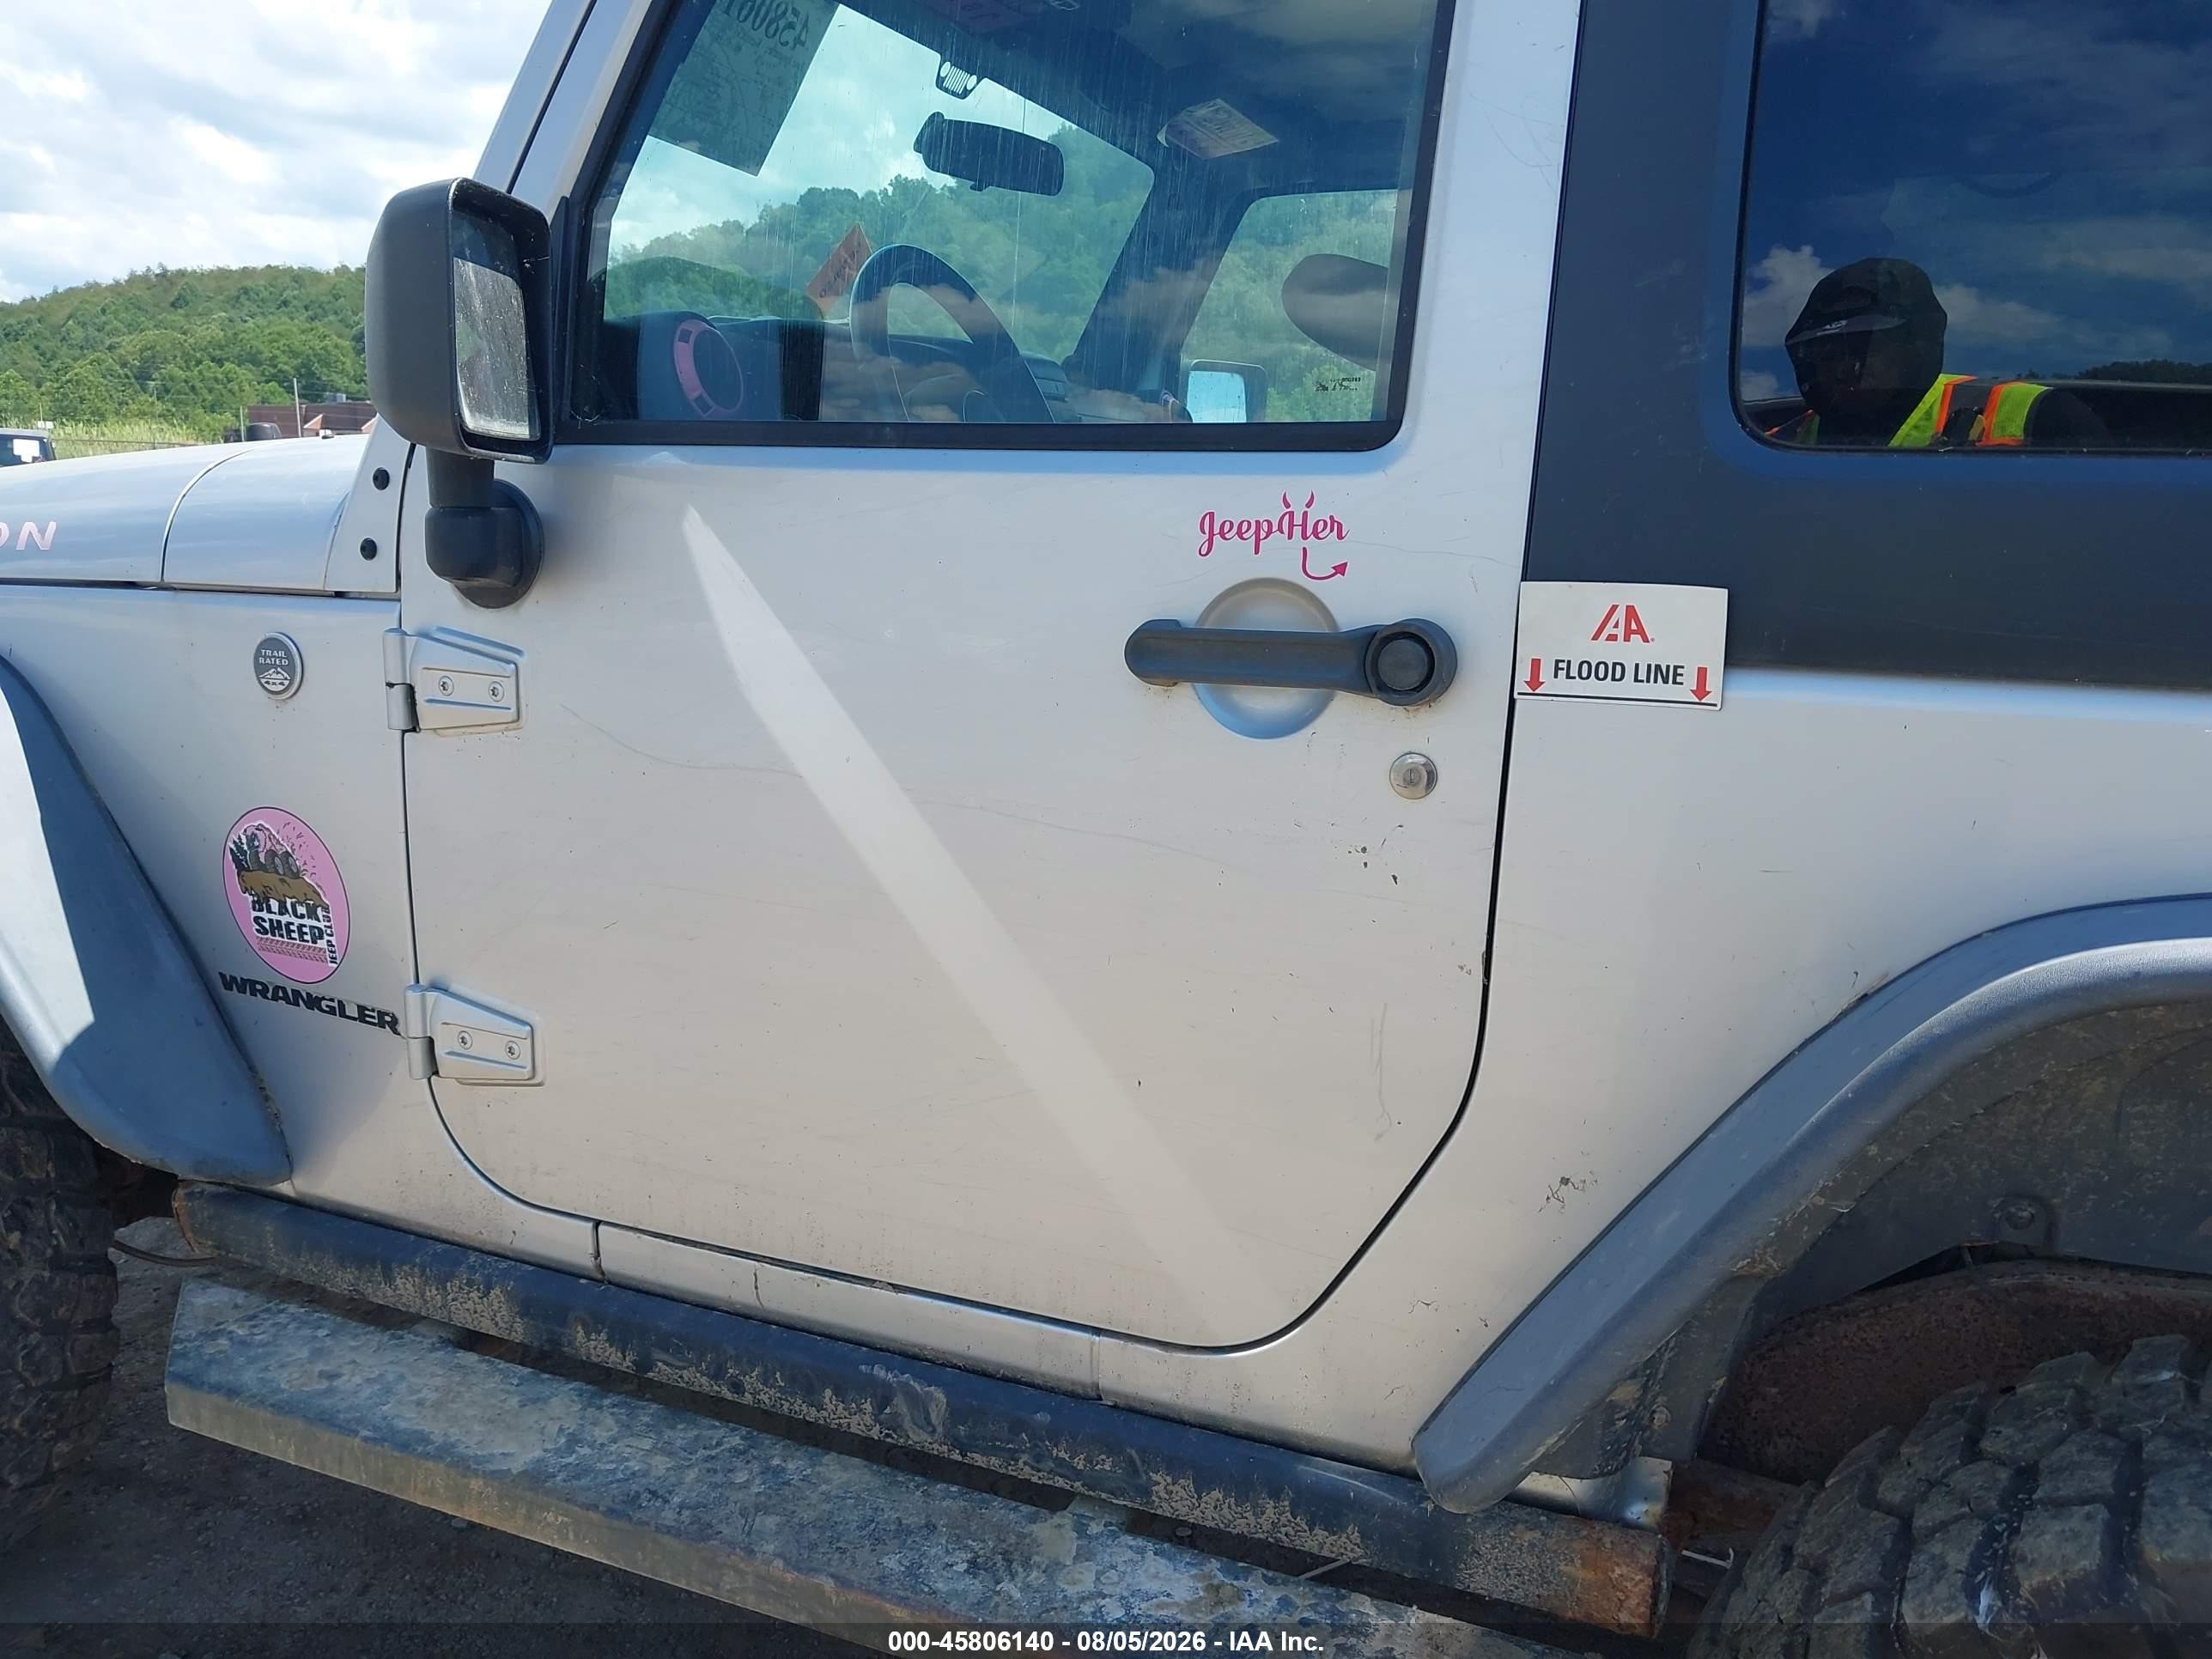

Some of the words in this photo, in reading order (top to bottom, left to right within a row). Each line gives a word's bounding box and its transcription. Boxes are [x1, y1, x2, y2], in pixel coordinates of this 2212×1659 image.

[258, 657, 289, 665] RATED
[260, 649, 288, 658] TRAIL
[1553, 659, 1626, 683] FLOOD
[1633, 662, 1685, 685] LINE
[252, 898, 321, 922] BLACK
[253, 915, 325, 945] SHEEP
[326, 939, 338, 964] JEEP
[218, 971, 402, 1036] WRANGLER
